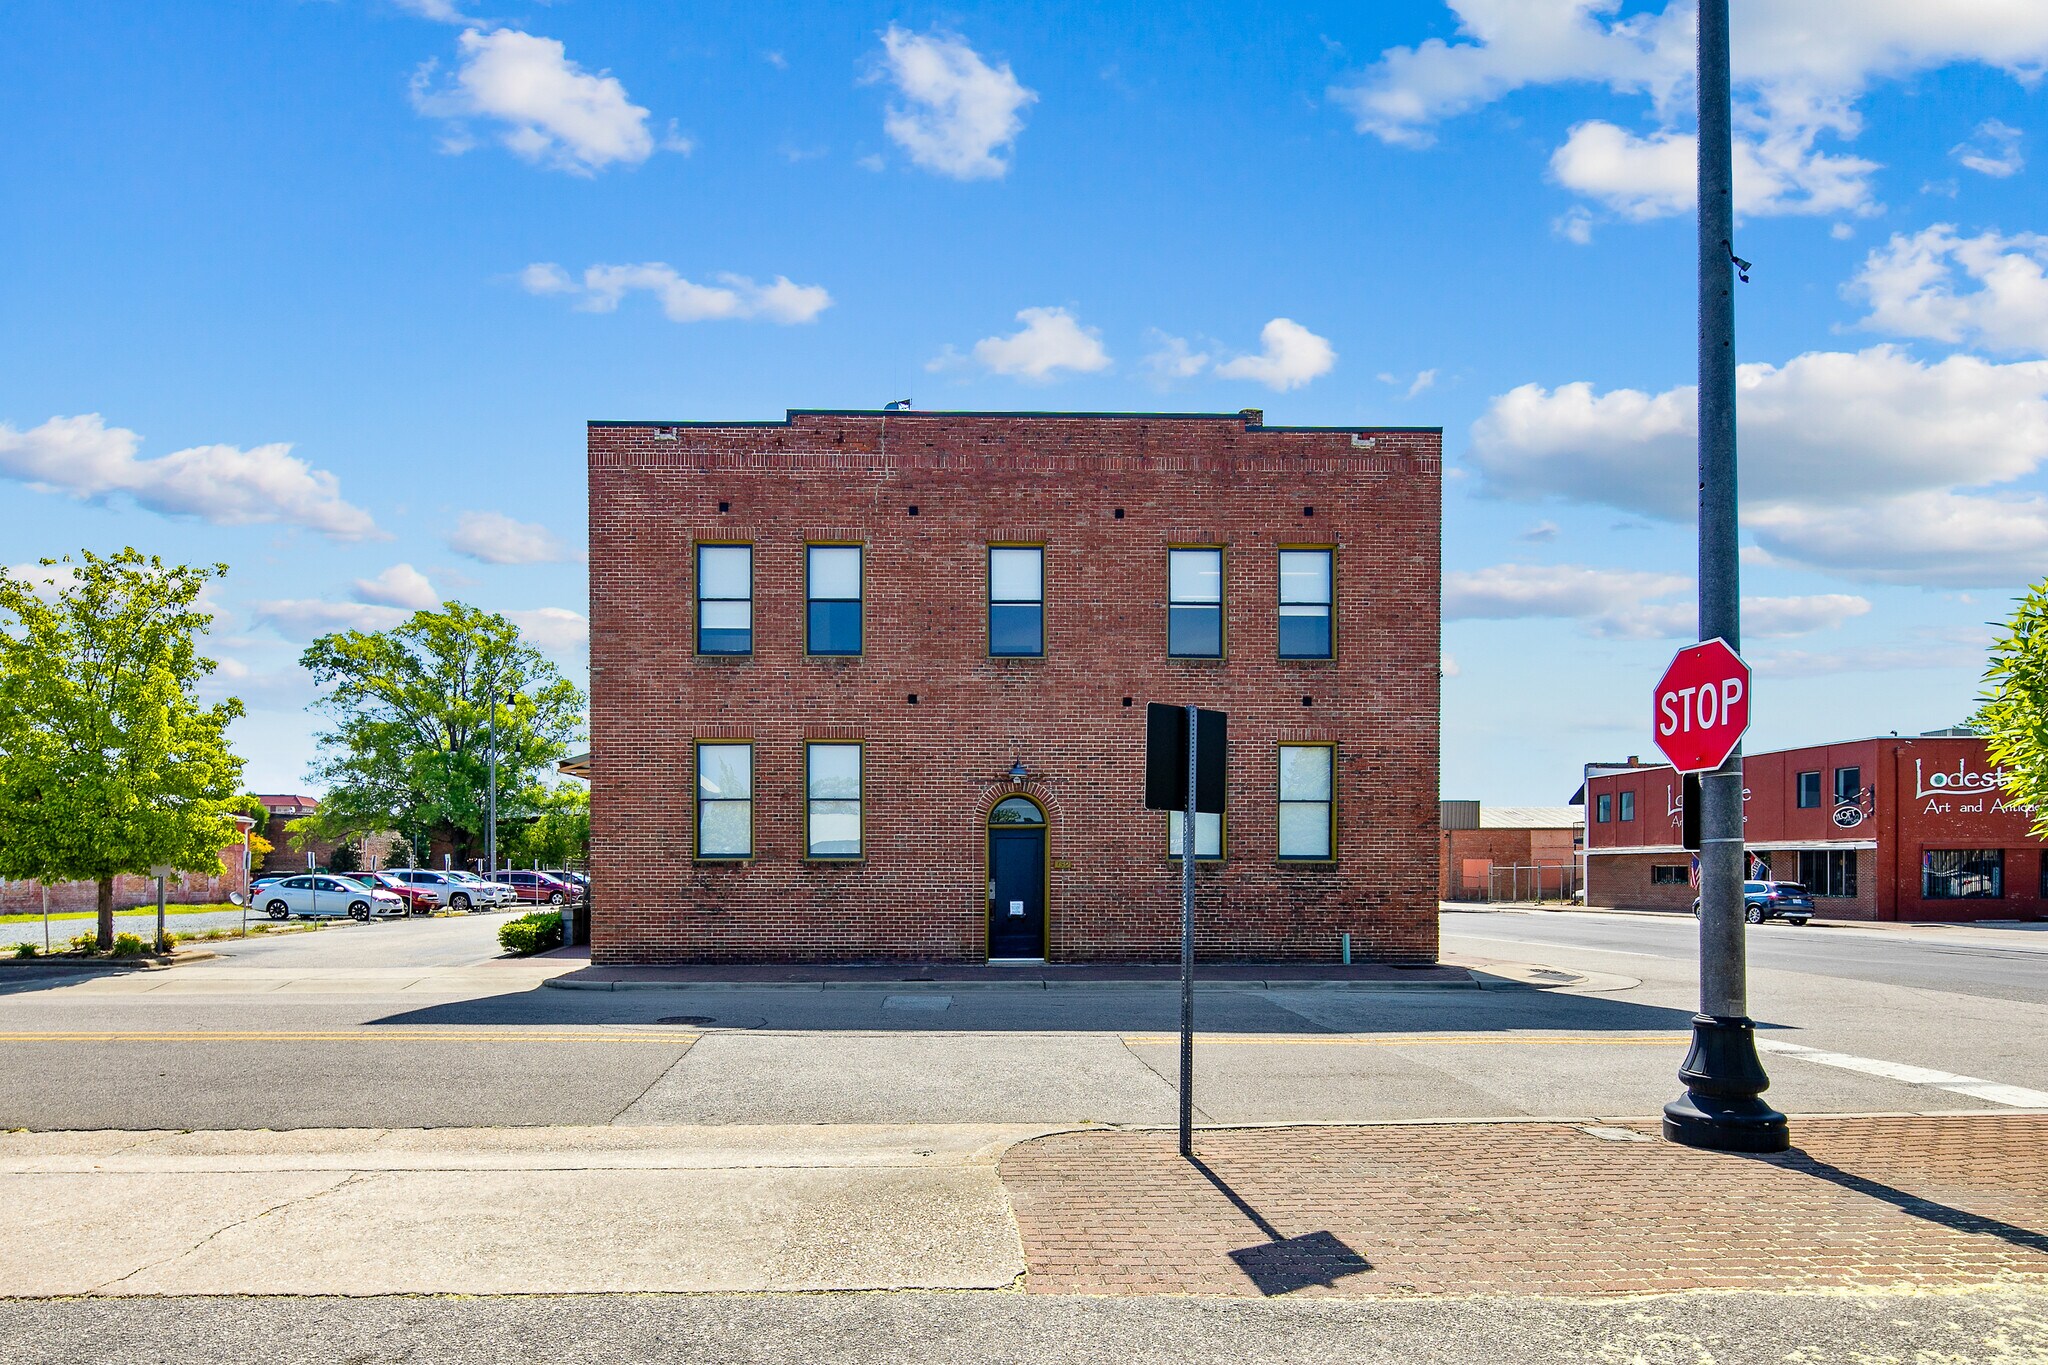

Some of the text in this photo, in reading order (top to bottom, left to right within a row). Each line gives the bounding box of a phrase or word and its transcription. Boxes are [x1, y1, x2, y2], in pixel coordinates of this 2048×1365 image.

[1659, 677, 1743, 736] STOP
[1915, 758, 2010, 799] Lodest
[1923, 798, 1951, 815] Art
[1960, 798, 1983, 813] and
